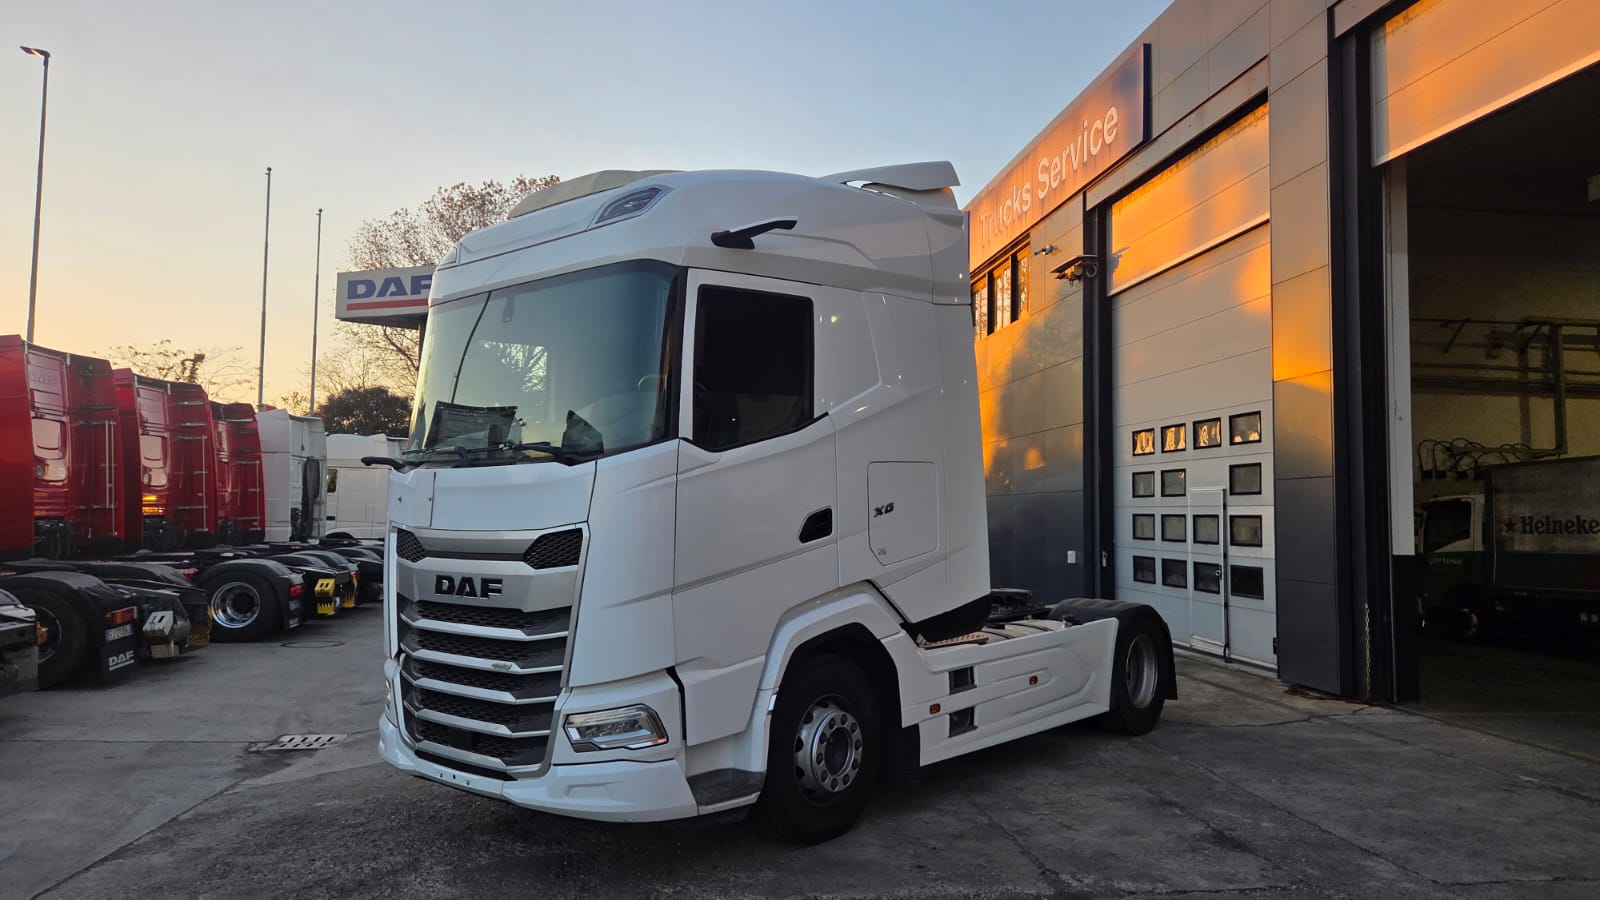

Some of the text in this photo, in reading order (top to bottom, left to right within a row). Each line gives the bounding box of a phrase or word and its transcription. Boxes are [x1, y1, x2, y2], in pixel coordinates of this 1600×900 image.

[978, 106, 1118, 248] Trucks Service
[347, 274, 432, 299] DAF
[434, 575, 503, 600] DAF
[108, 650, 134, 666] DAF
